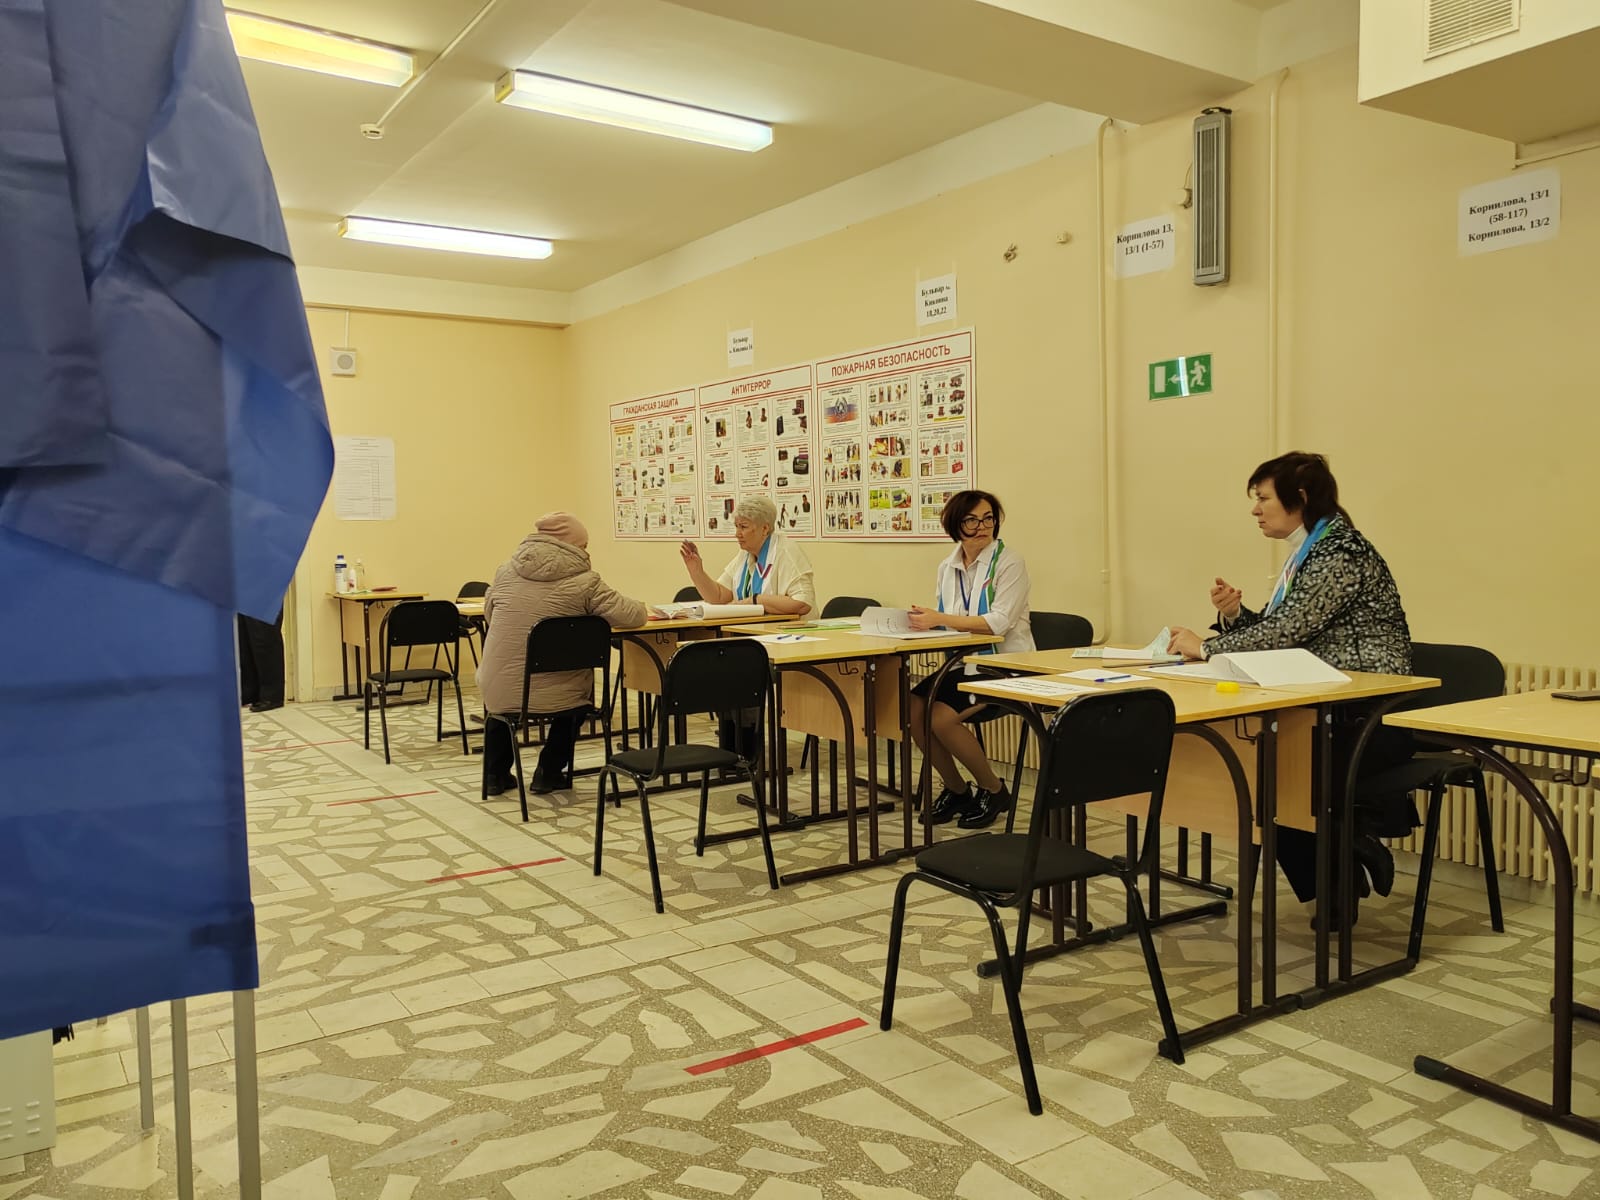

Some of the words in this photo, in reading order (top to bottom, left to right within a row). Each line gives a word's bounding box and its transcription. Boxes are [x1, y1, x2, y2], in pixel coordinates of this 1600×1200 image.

[1469, 197, 1527, 215] Корнилова,
[1530, 189, 1550, 201] 13/1
[1489, 208, 1528, 225] (58-117)
[1116, 228, 1160, 244] Корнилова
[1468, 224, 1526, 242] Корнилова,
[1530, 217, 1550, 229] 13/2
[1125, 244, 1139, 256] 13/1
[1141, 239, 1164, 253] (1-57)
[831, 358, 876, 377] ПОЖАРНАЯ
[877, 344, 951, 368] БЕЗОПАСНОСТЬ
[731, 379, 772, 395] АНТИТЕРРОР
[623, 401, 657, 416] ГРАЖДАНСКАЯ
[657, 397, 679, 409] ЗАЩИТА
